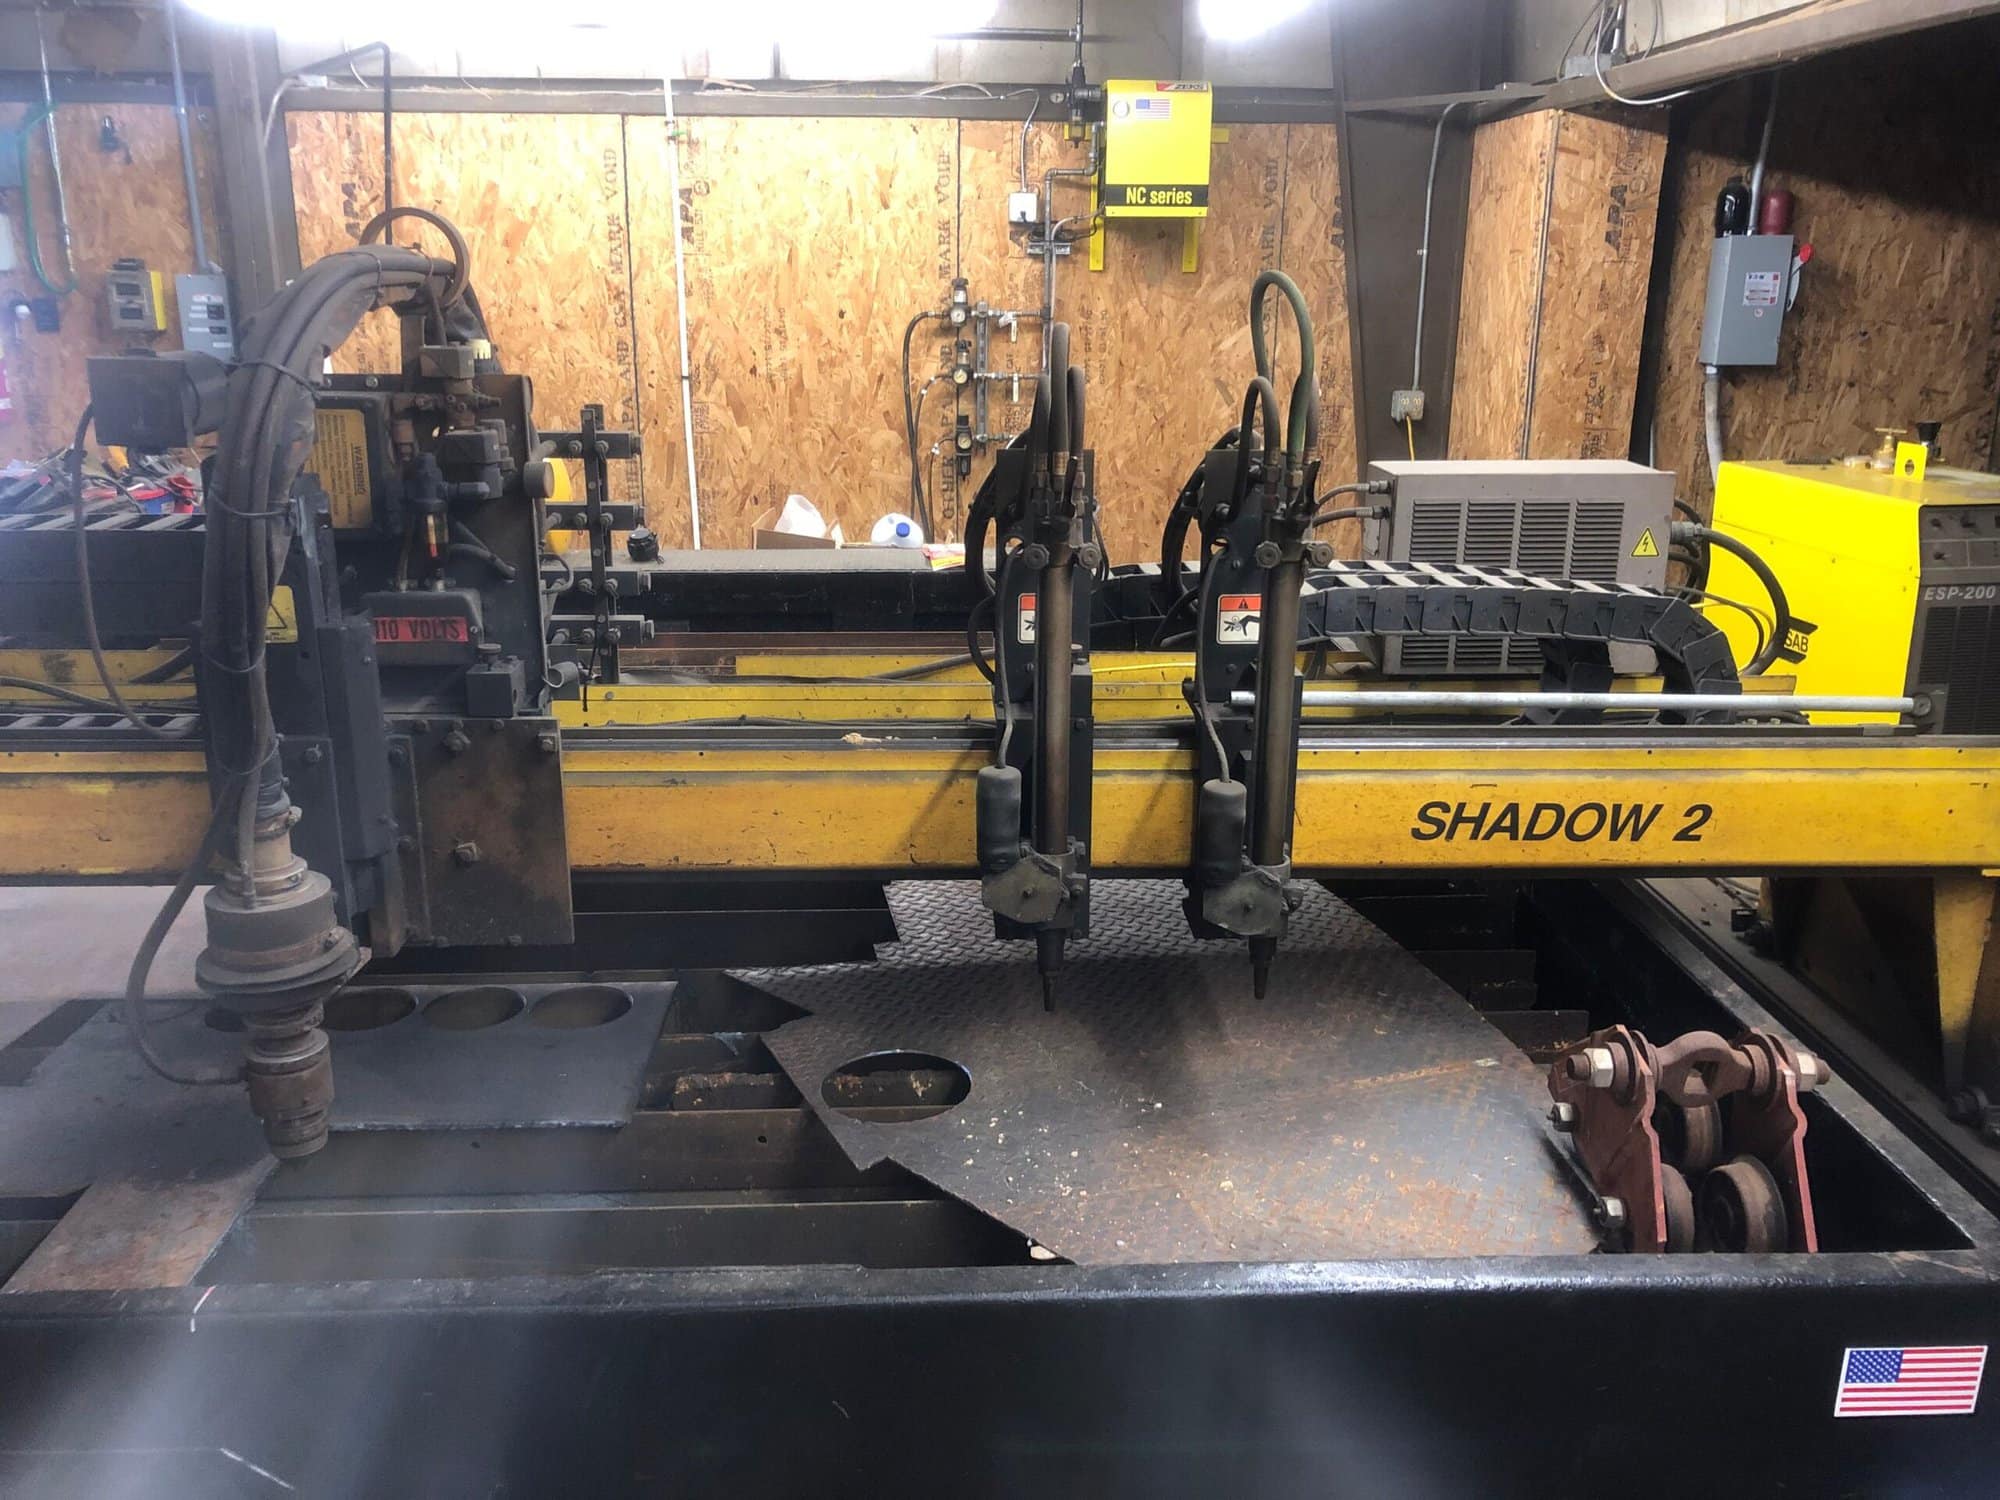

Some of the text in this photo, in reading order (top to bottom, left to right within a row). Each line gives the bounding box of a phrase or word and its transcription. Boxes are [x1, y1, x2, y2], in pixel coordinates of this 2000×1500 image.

[603, 149, 618, 200] VOID
[1126, 187, 1193, 204] NC series
[341, 183, 363, 240] APA
[679, 187, 696, 246] APA
[1605, 184, 1628, 257] APA
[938, 217, 952, 280] MARK
[1260, 222, 1276, 272] ARK
[614, 289, 629, 328] CSA
[616, 340, 632, 380] AND
[353, 445, 367, 494] WARNING
[1924, 585, 1996, 601] ESP-200
[409, 618, 461, 641] VOLTS
[1784, 629, 1809, 652] SAB
[1411, 801, 1713, 842] SHADOW 2
